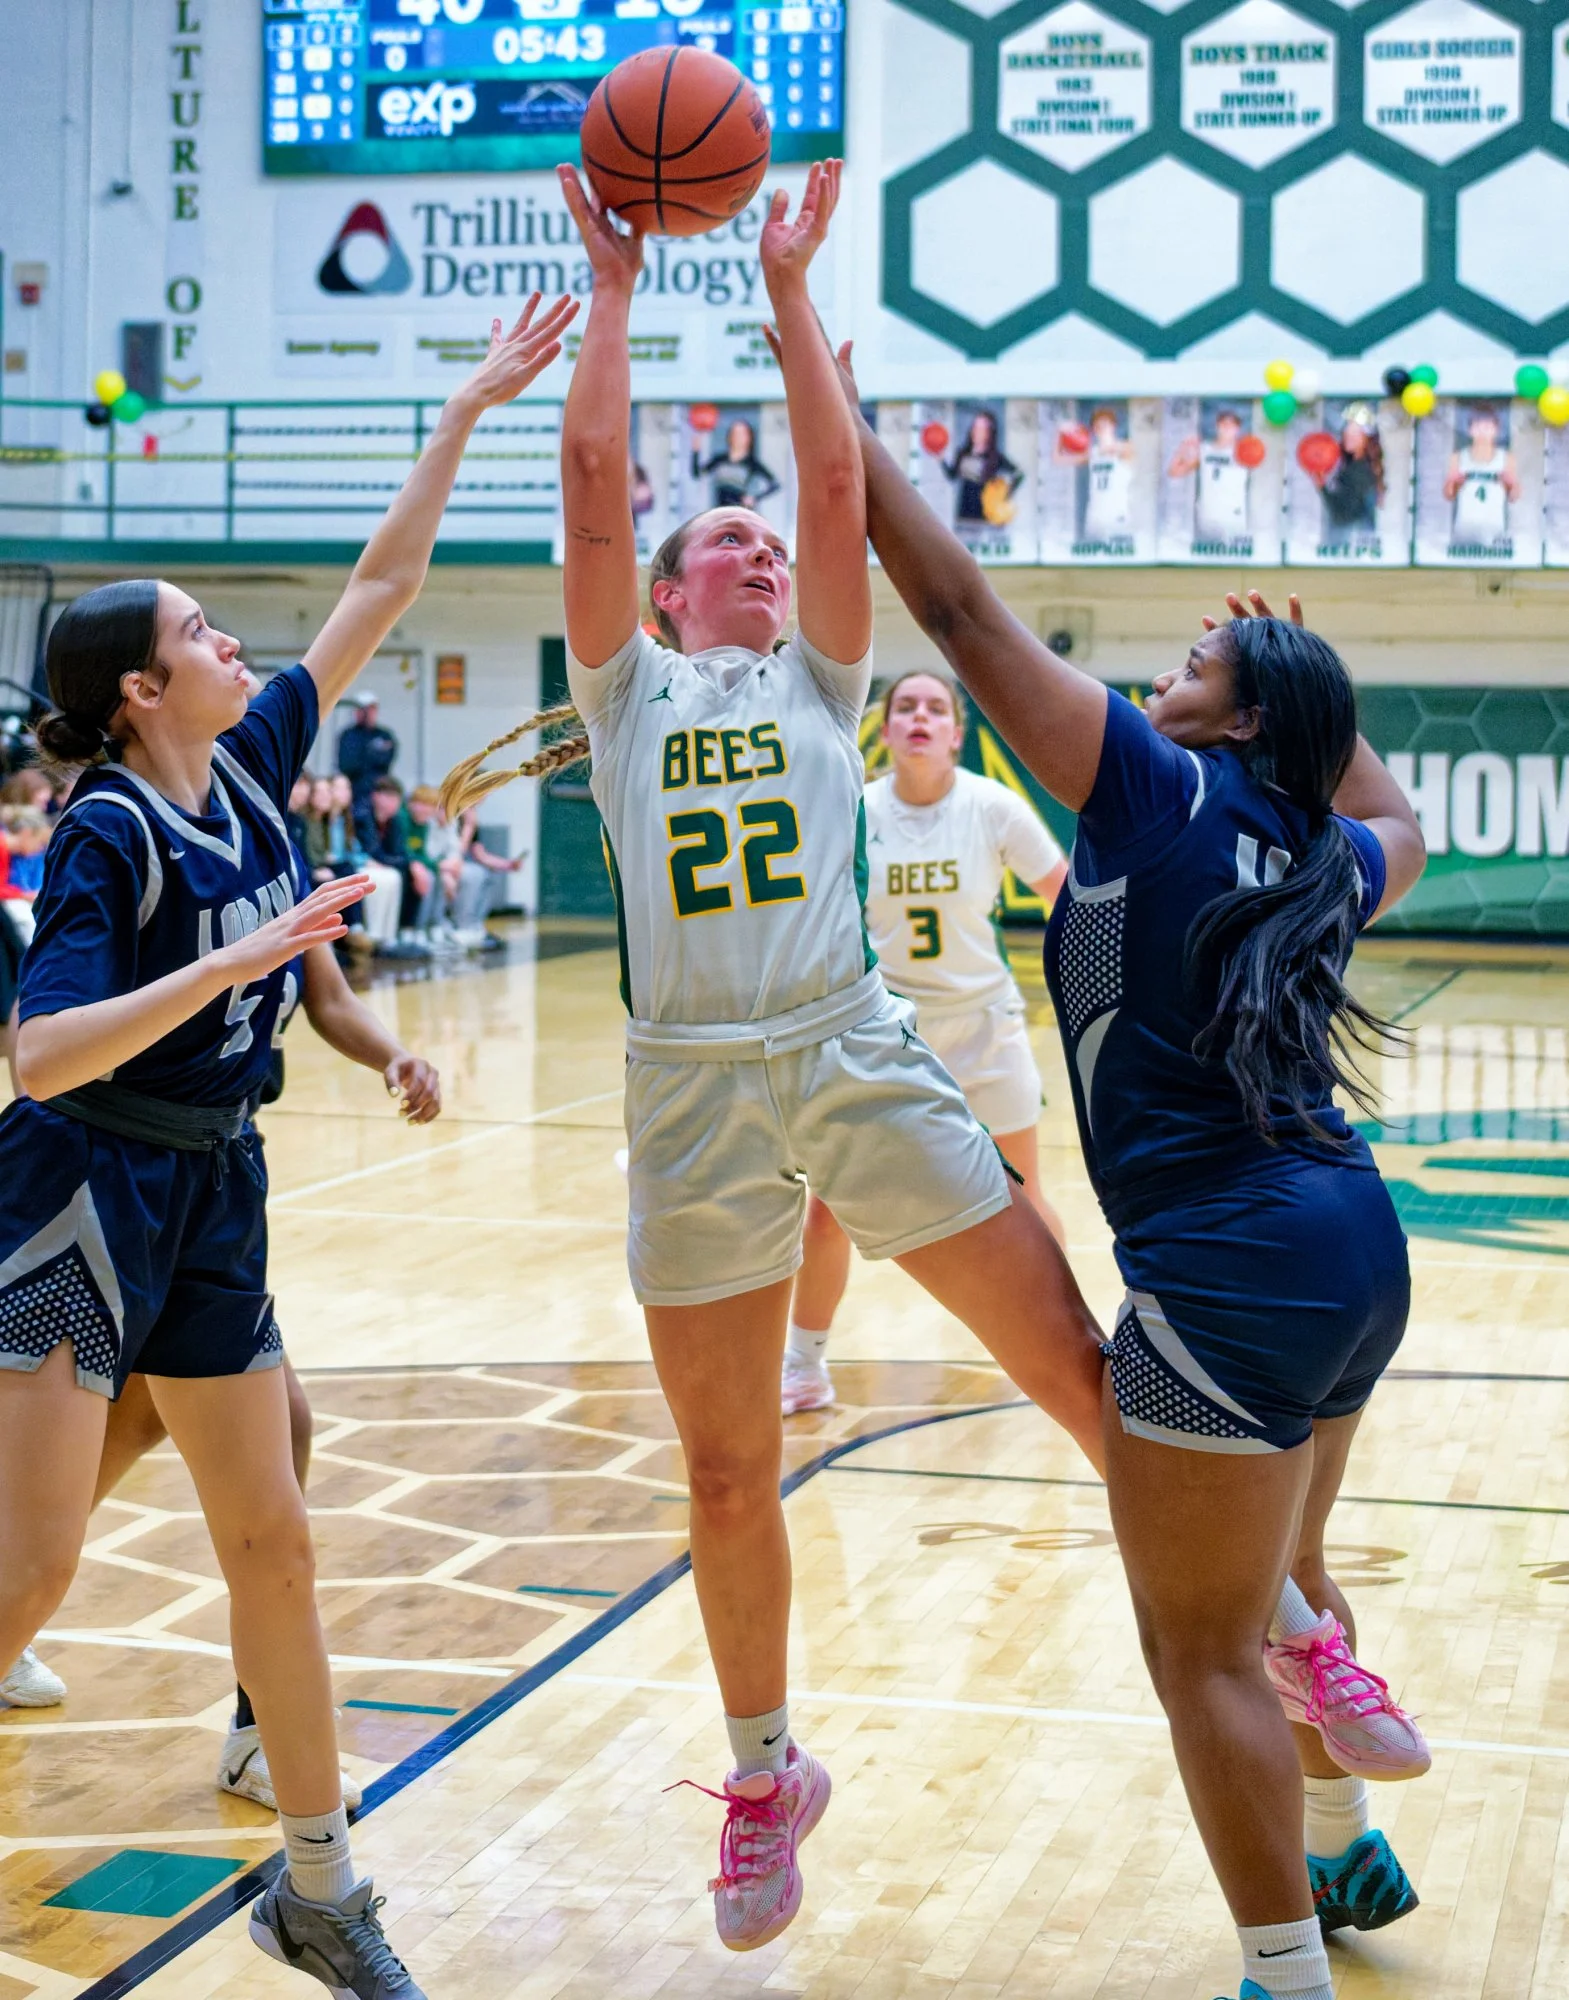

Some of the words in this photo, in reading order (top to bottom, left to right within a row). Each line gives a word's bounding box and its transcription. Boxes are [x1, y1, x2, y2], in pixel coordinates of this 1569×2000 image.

[493, 25, 606, 64] 05:43
[1047, 32, 1103, 49] BOYS
[1371, 40, 1431, 60] GIRLS
[1434, 38, 1515, 58] SOCCER
[384, 45, 408, 72] 0
[1006, 51, 1143, 69] BASKETBALL
[1190, 46, 1247, 64] BOYS
[1253, 42, 1328, 63] TRACK
[1036, 99, 1100, 115] DIVISION
[1221, 91, 1286, 108] DIVISION
[1403, 86, 1470, 104] DIVISION
[378, 80, 477, 136] exp
[1194, 111, 1235, 128] STATE
[1239, 108, 1323, 127] RUNNER-UP
[1376, 107, 1420, 124] STATE
[1422, 104, 1509, 124] RUNNER-UP
[1011, 118, 1051, 135] STATE
[1055, 118, 1093, 134] FINAL
[1097, 117, 1136, 132] FOUR
[422, 250, 764, 305] Dermalogy
[165, 275, 203, 361] OF
[661, 721, 788, 792] BEES
[666, 797, 808, 920] 22
[887, 859, 959, 896] BEES
[905, 906, 944, 961] 3
[218, 982, 264, 1059] 5
